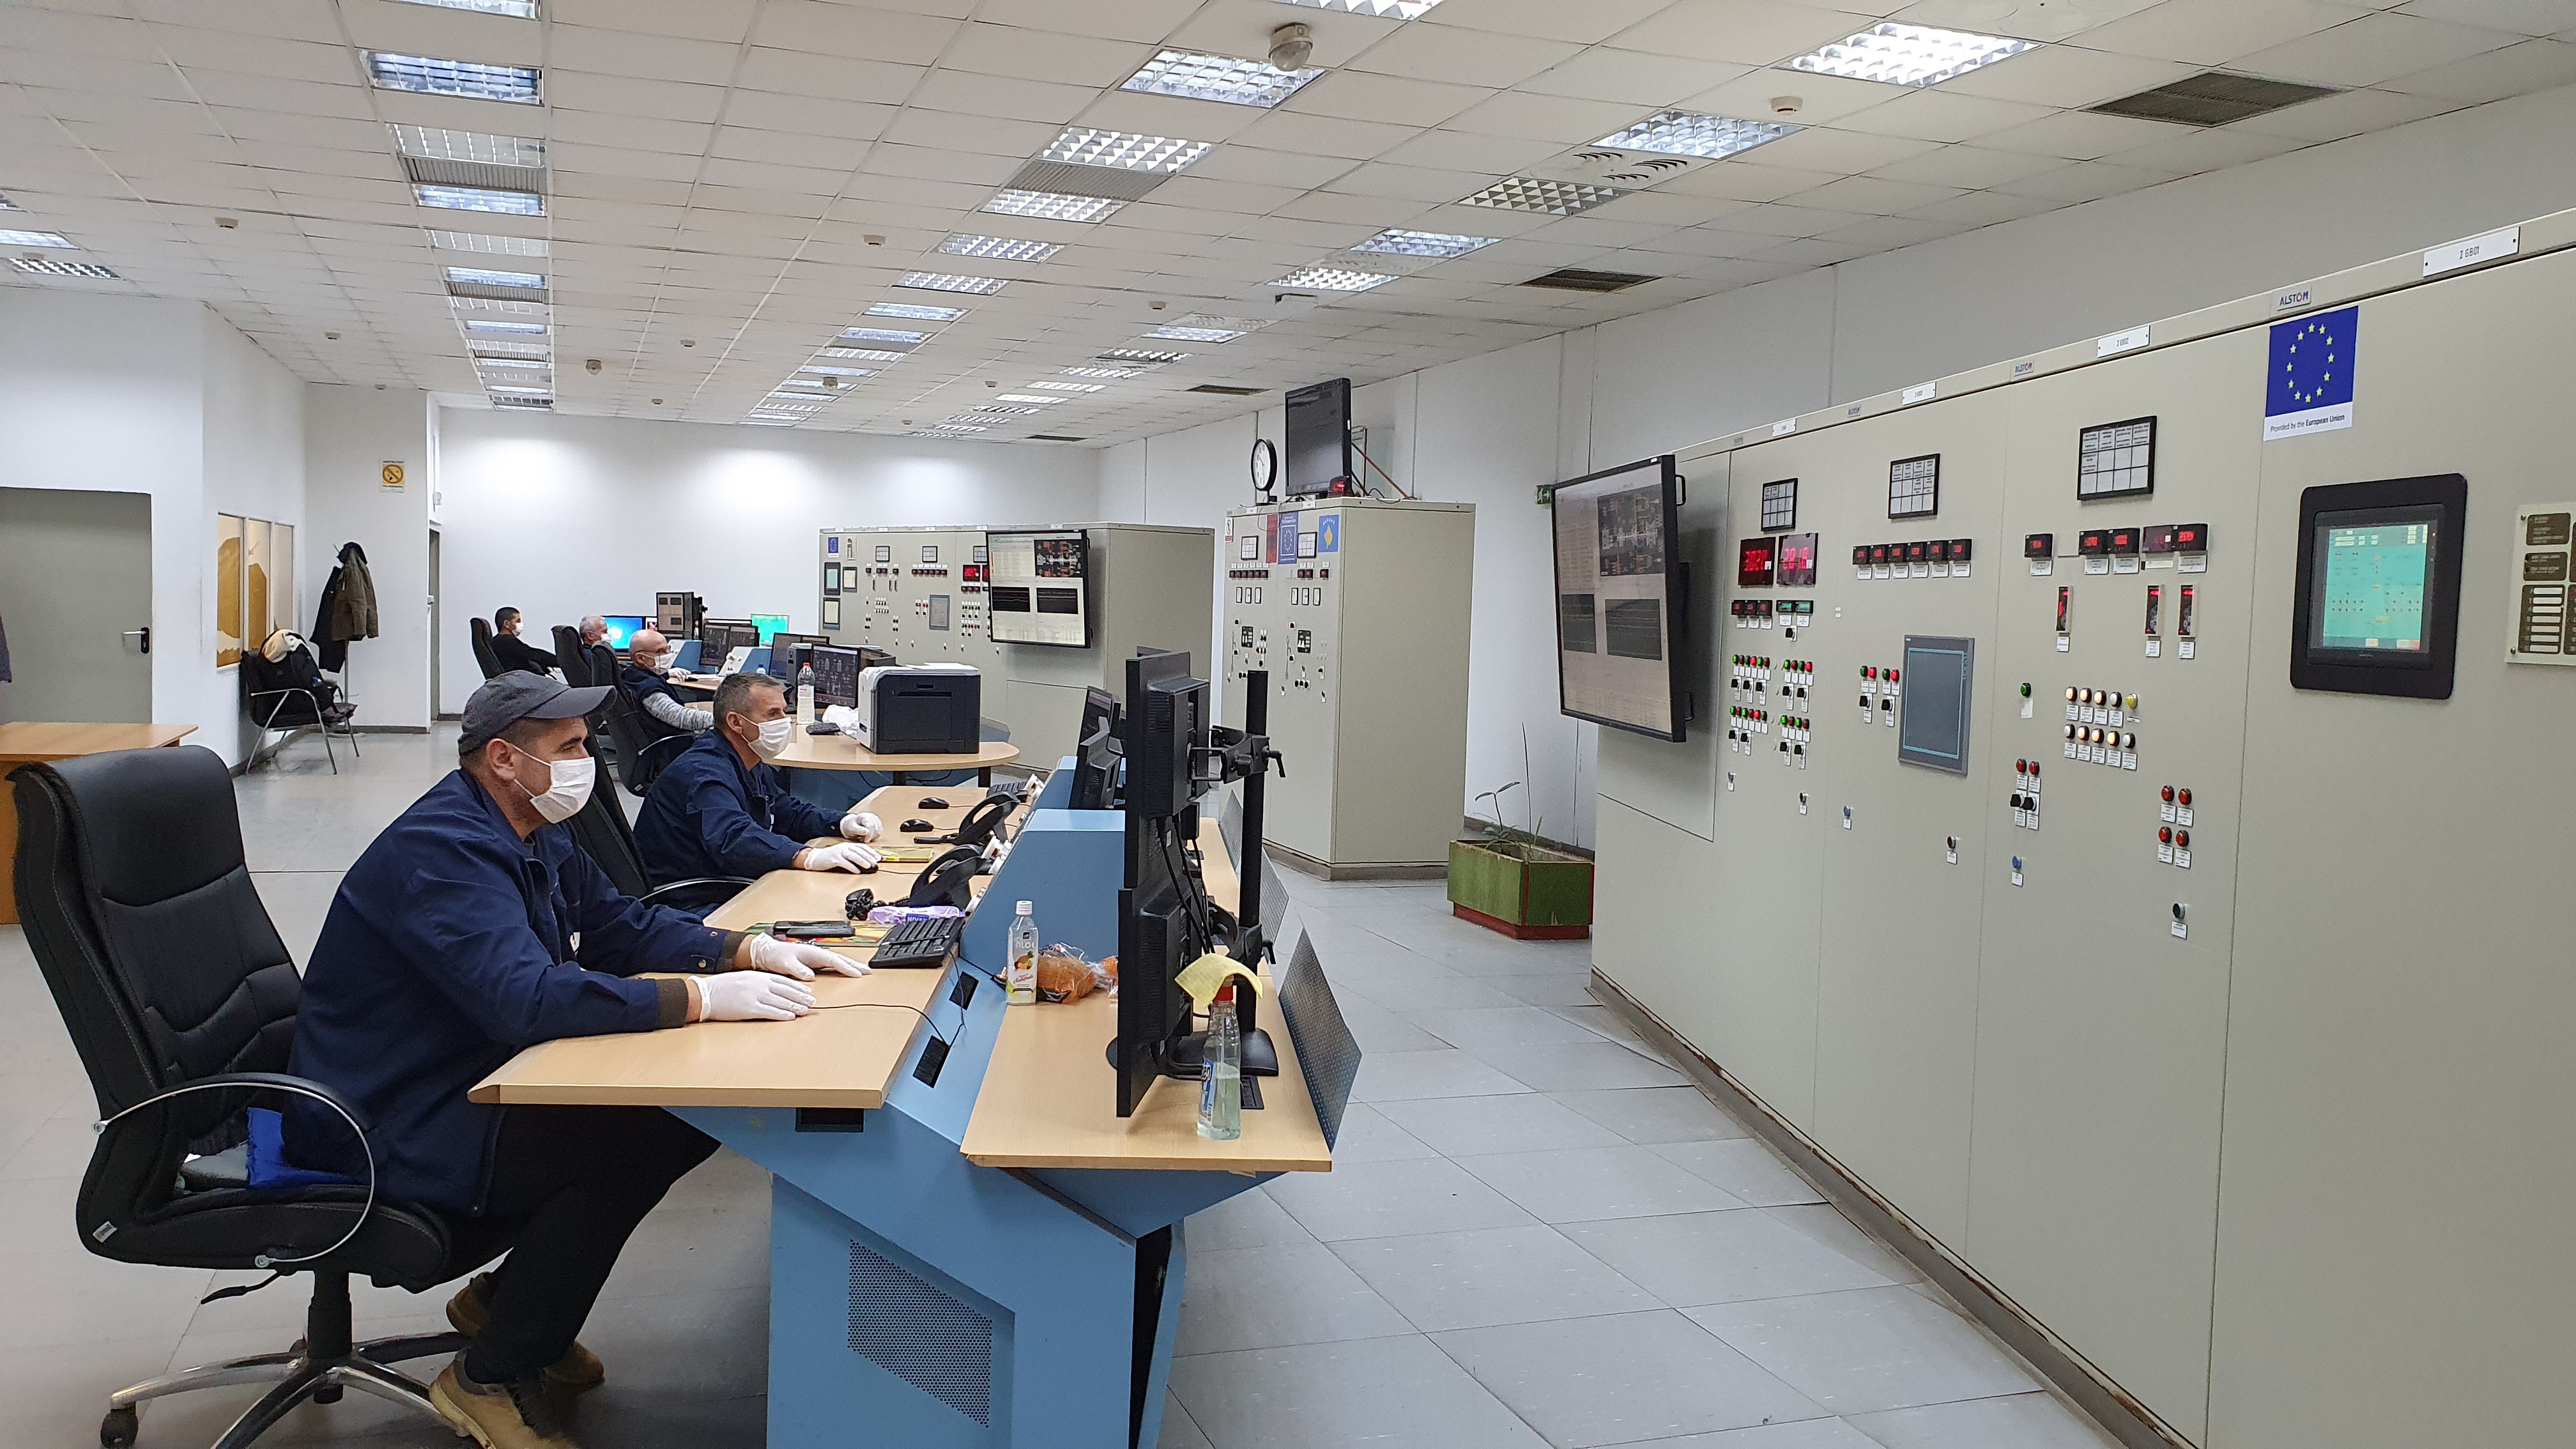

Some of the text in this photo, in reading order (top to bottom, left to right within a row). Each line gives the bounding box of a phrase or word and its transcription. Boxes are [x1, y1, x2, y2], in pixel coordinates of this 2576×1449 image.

[2279, 291, 2308, 306] ALSTOM
[2271, 422, 2289, 432] Provided
[2306, 418, 2329, 426] European
[2329, 414, 2345, 422] Union
